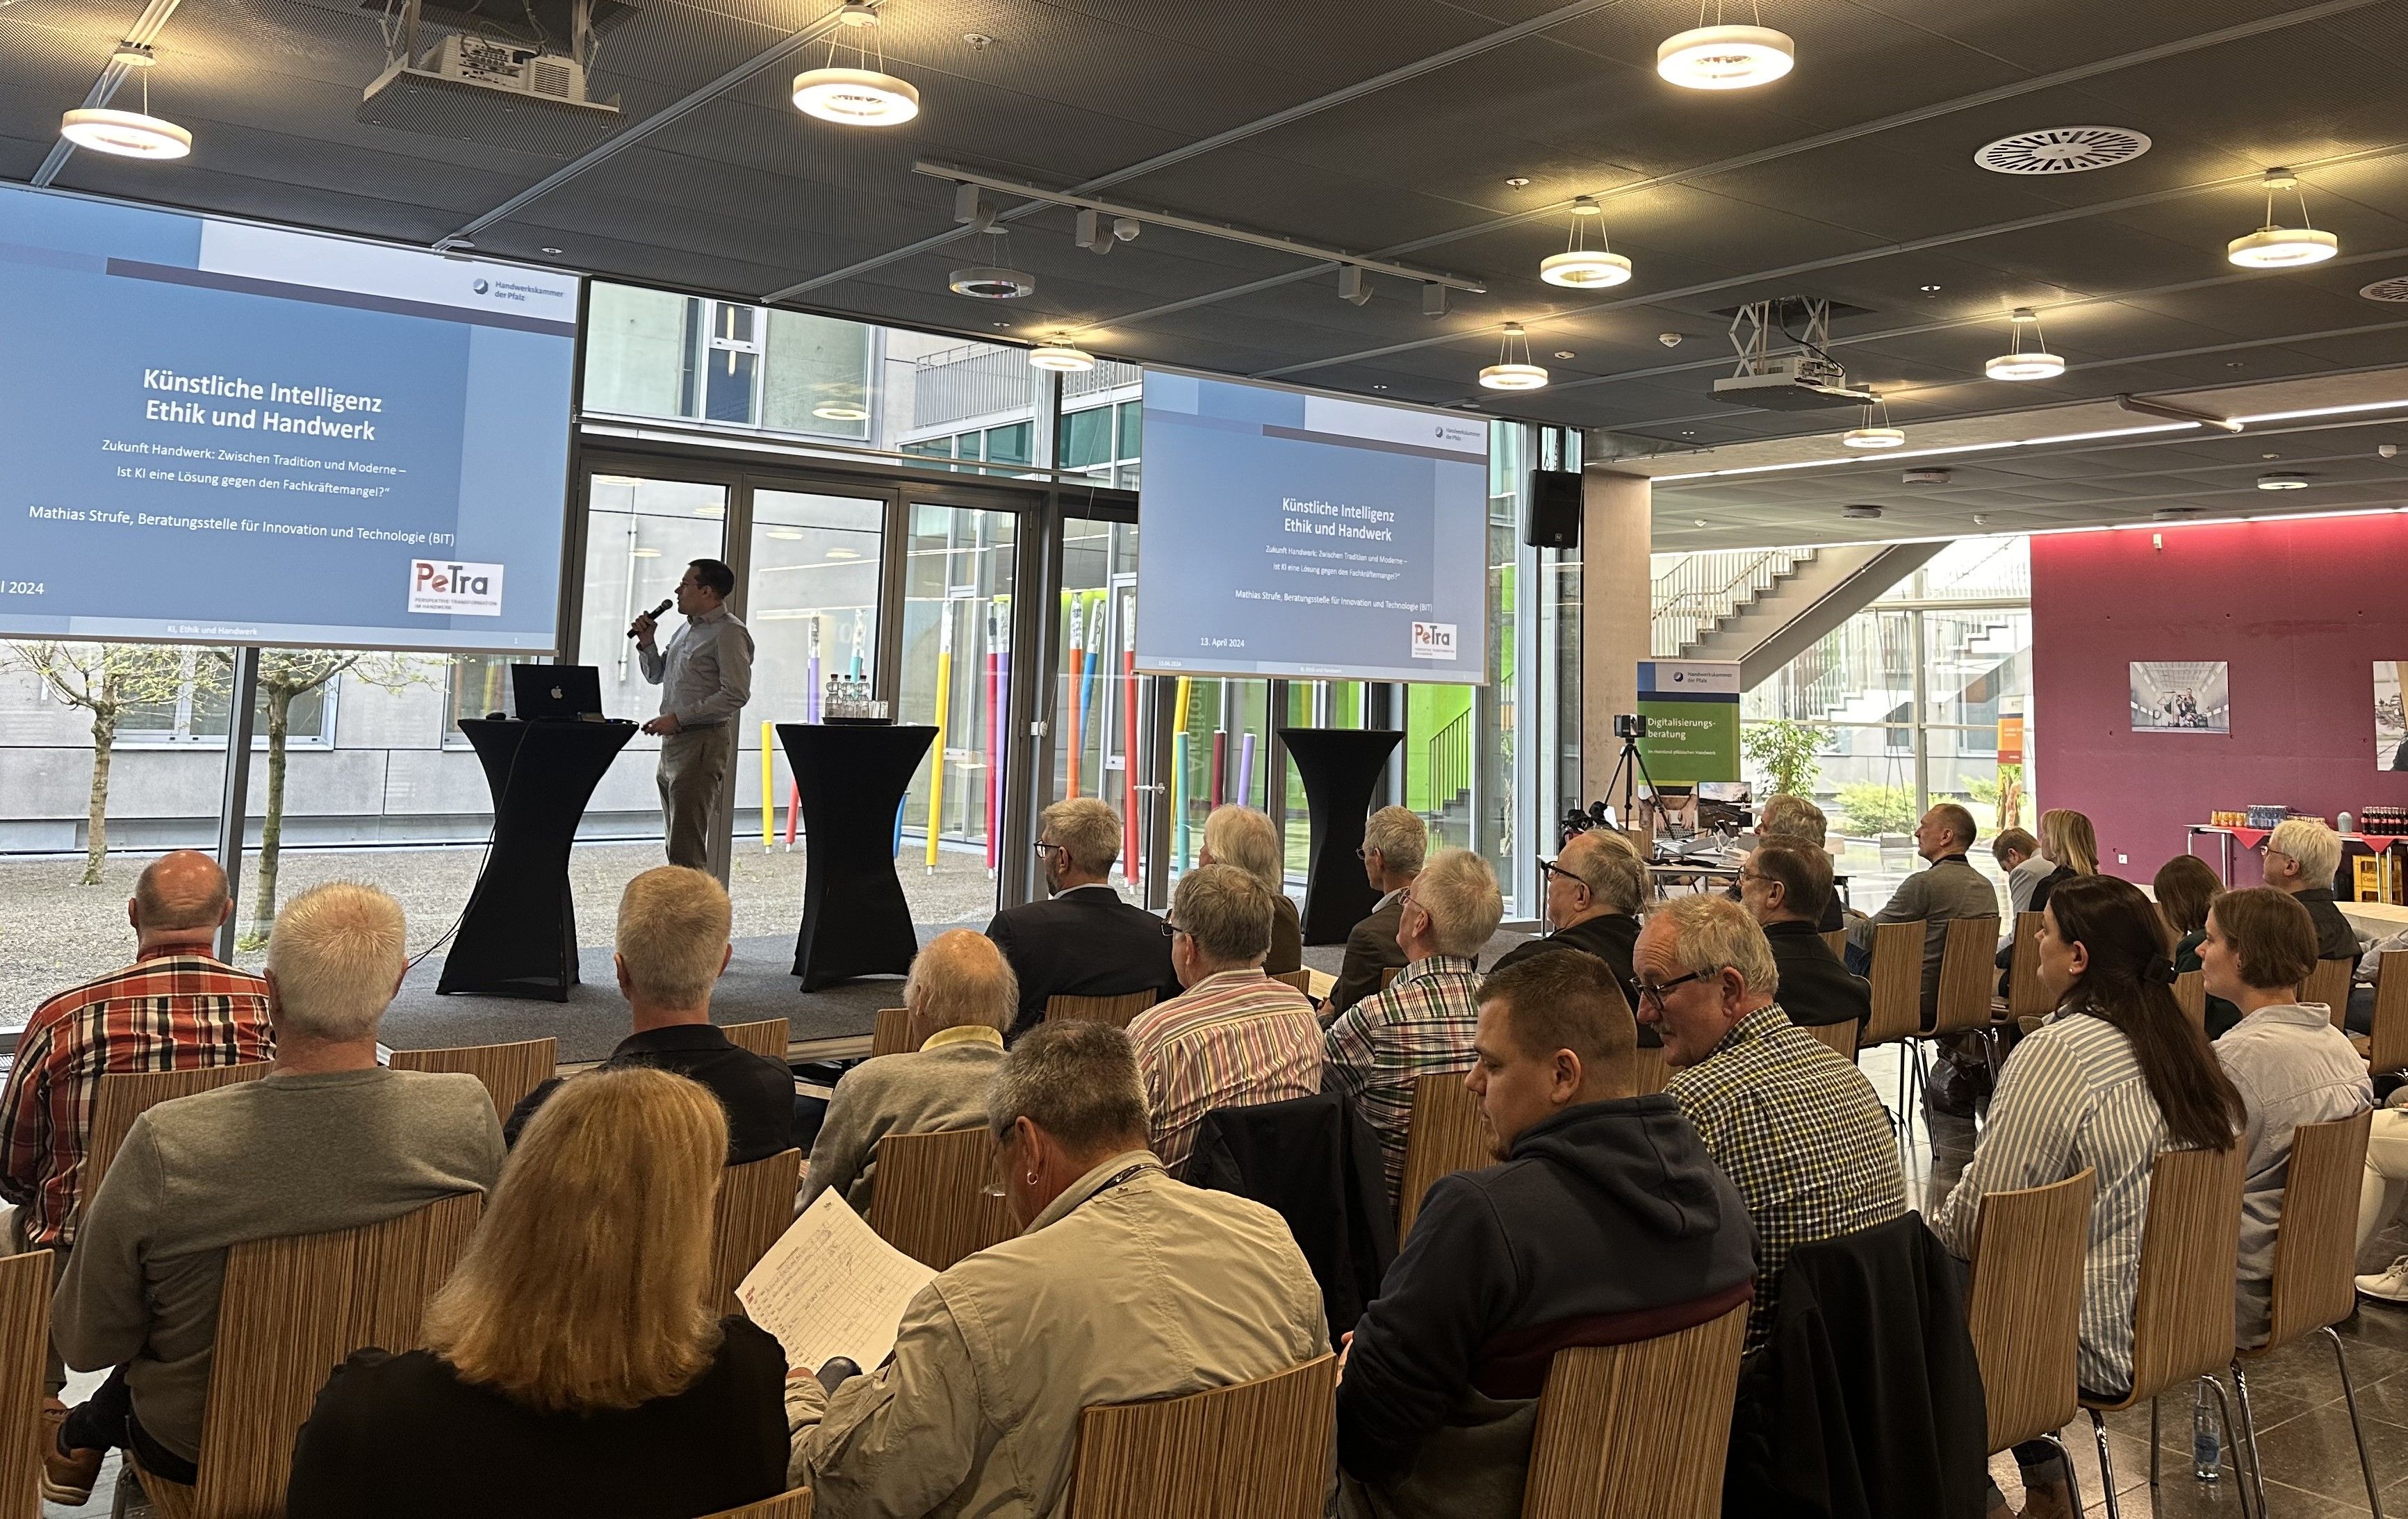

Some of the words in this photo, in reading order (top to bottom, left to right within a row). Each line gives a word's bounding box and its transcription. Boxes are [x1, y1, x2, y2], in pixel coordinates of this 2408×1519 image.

[495, 281, 564, 297] Handwerkskammer
[508, 293, 525, 301] Pfalz
[144, 368, 263, 400] Künstliche
[270, 382, 382, 413] Intelligenz
[146, 400, 206, 424] Ethik
[212, 409, 256, 429] und
[263, 411, 375, 441] Handwerk
[101, 439, 149, 454] Zukunft
[151, 444, 215, 459] Handwerk:
[218, 449, 270, 463] Zwischen
[273, 454, 321, 469] Tradition
[324, 461, 345, 470] und
[348, 461, 396, 475] Moderne
[117, 466, 131, 477] Ist
[135, 468, 146, 479] KI
[149, 469, 175, 481] eine
[178, 471, 219, 486] Lösung
[221, 476, 256, 488] gegen
[259, 478, 279, 489] den
[1282, 497, 1338, 516] Künstliche
[1341, 504, 1395, 523] Intelligenz
[28, 506, 85, 521] Mathias
[89, 509, 133, 525] Strufe,
[138, 513, 238, 531] Beratungsstelle
[241, 519, 259, 532] für
[263, 521, 327, 536] Innovation
[331, 527, 353, 539] und
[357, 527, 425, 545] Technologie
[429, 532, 455, 547] (BIT)
[1284, 518, 1312, 534] Ethik
[1315, 523, 1336, 536] und
[1338, 523, 1392, 542] Handwerk
[1266, 545, 1287, 555] Zukunft
[1318, 550, 1343, 559] Zwischen
[1344, 552, 1367, 561] Tradition
[1379, 555, 1403, 565] Moderne
[8, 582, 44, 594] 2024
[416, 563, 489, 595] PeTra
[1235, 589, 1261, 599] Mathias
[1262, 591, 1283, 602] Strufe,
[1284, 593, 1330, 605] Beratungsstelle
[1331, 596, 1341, 605] für
[1341, 598, 1372, 607] Innovation
[1385, 600, 1418, 611] Technologie
[179, 625, 200, 634] Ethik
[218, 627, 257, 635] Handwerk
[1414, 624, 1450, 646] PeTra
[1201, 637, 1210, 646] 13.
[1211, 638, 1227, 648] April
[1229, 639, 1245, 648] 2024
[1648, 718, 1717, 730] Digitalisierungs-
[1648, 730, 1686, 741] beratung
